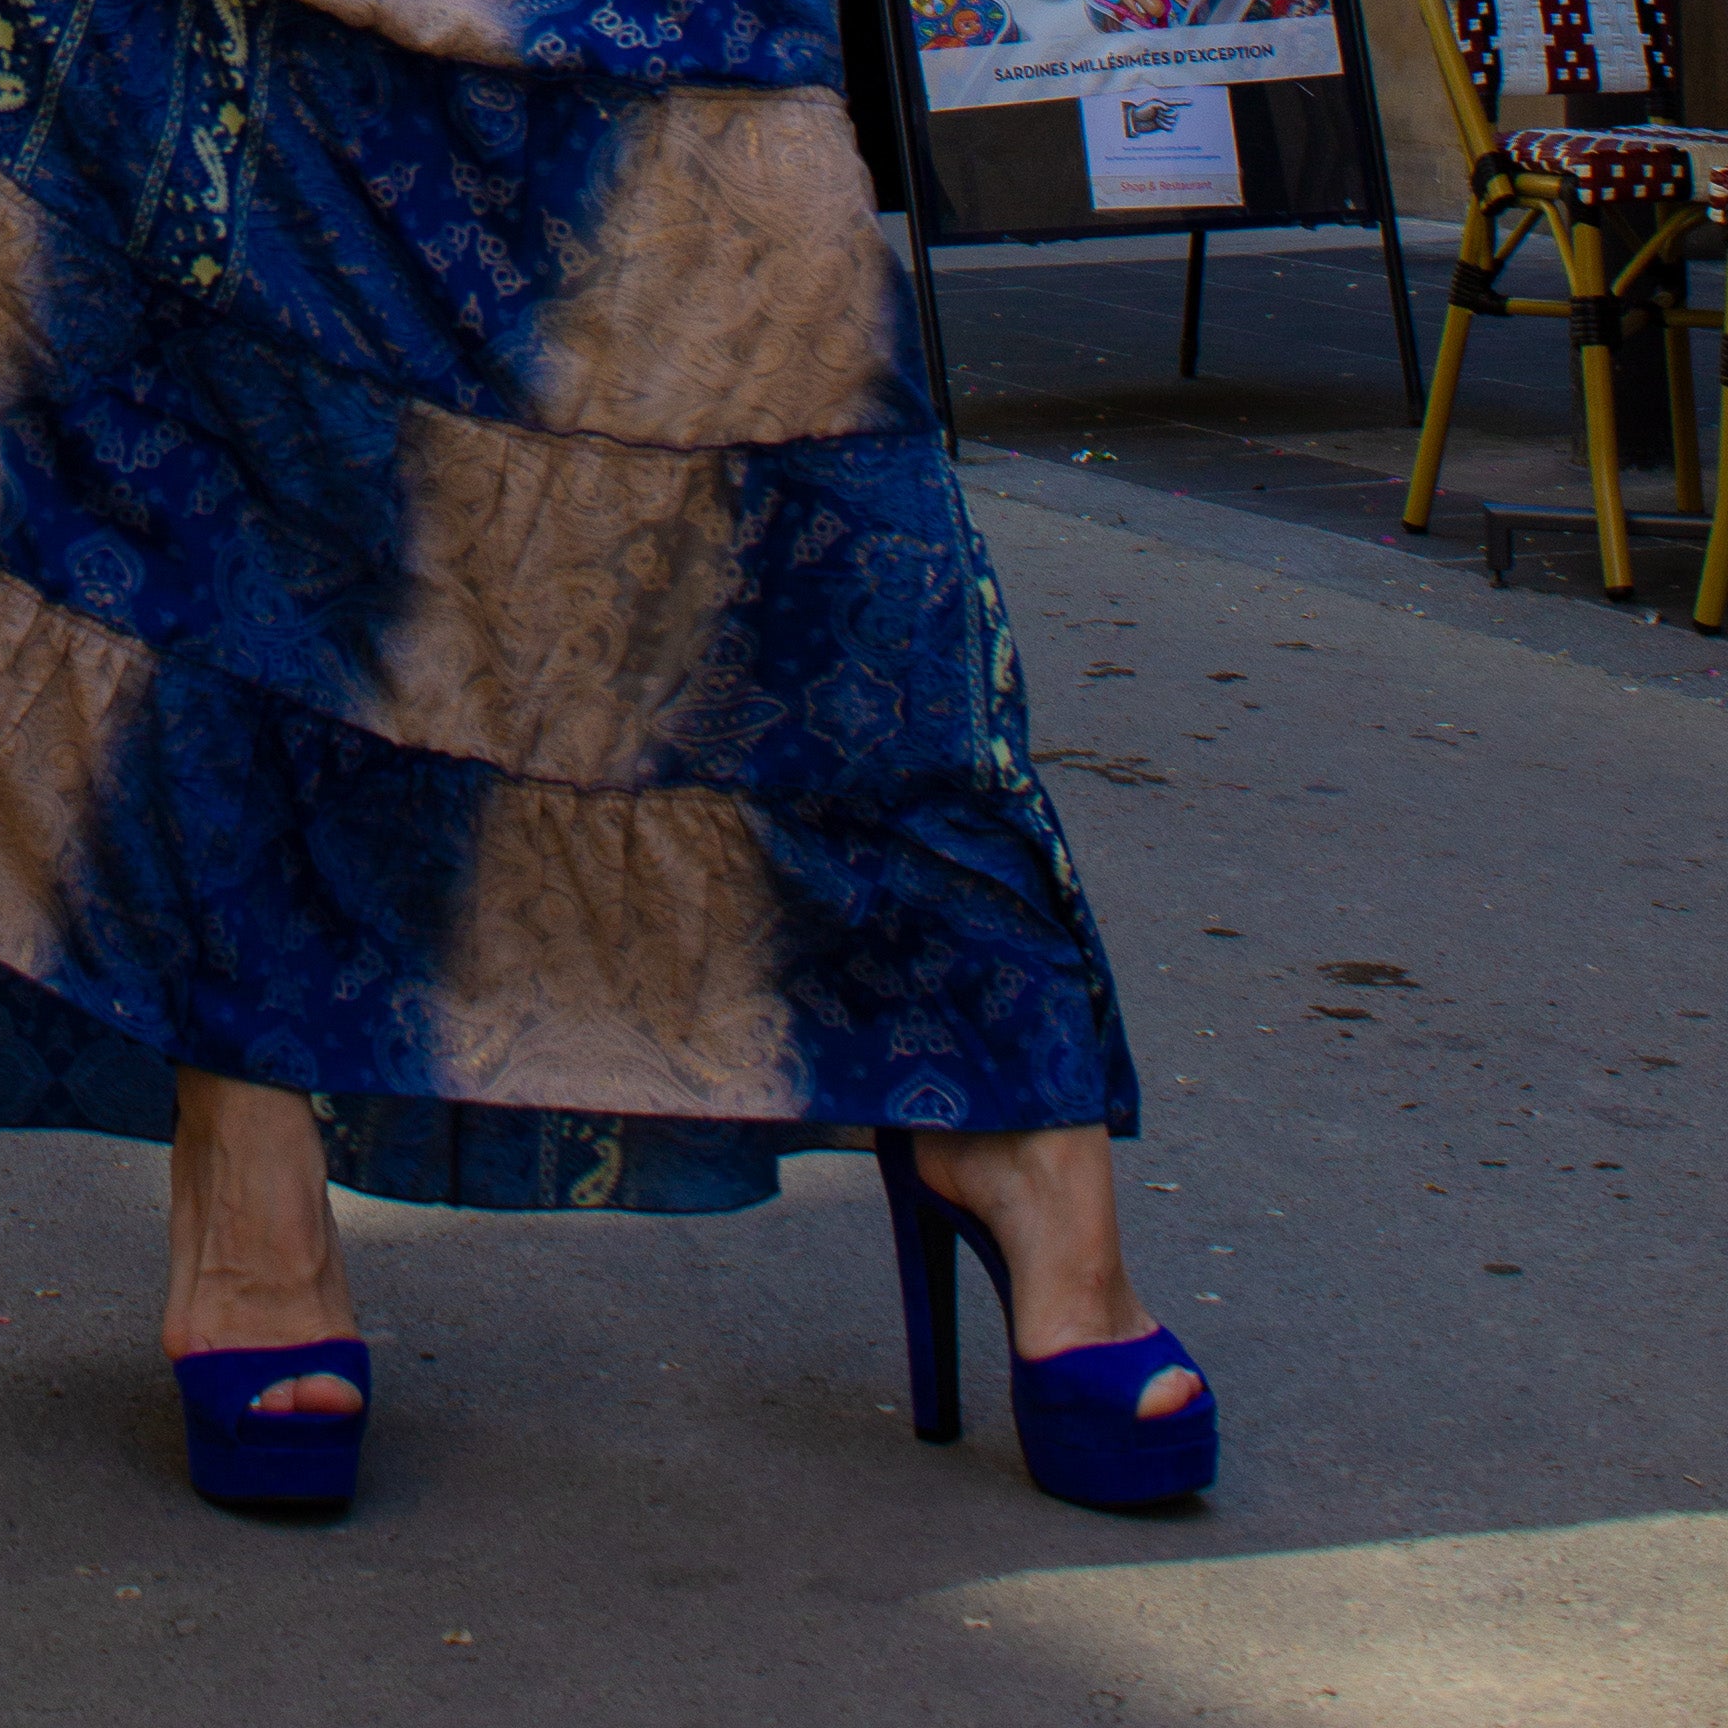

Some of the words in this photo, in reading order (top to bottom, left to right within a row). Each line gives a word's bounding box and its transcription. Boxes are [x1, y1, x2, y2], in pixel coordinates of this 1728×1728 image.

[993, 62, 1069, 82] SARDINES
[1070, 48, 1169, 73] MILLÉSIMÉES
[1172, 43, 1276, 66] D'EXCEPTION
[1120, 180, 1145, 193] Shop
[1147, 180, 1157, 192] &
[1159, 180, 1213, 192] Restaurant
